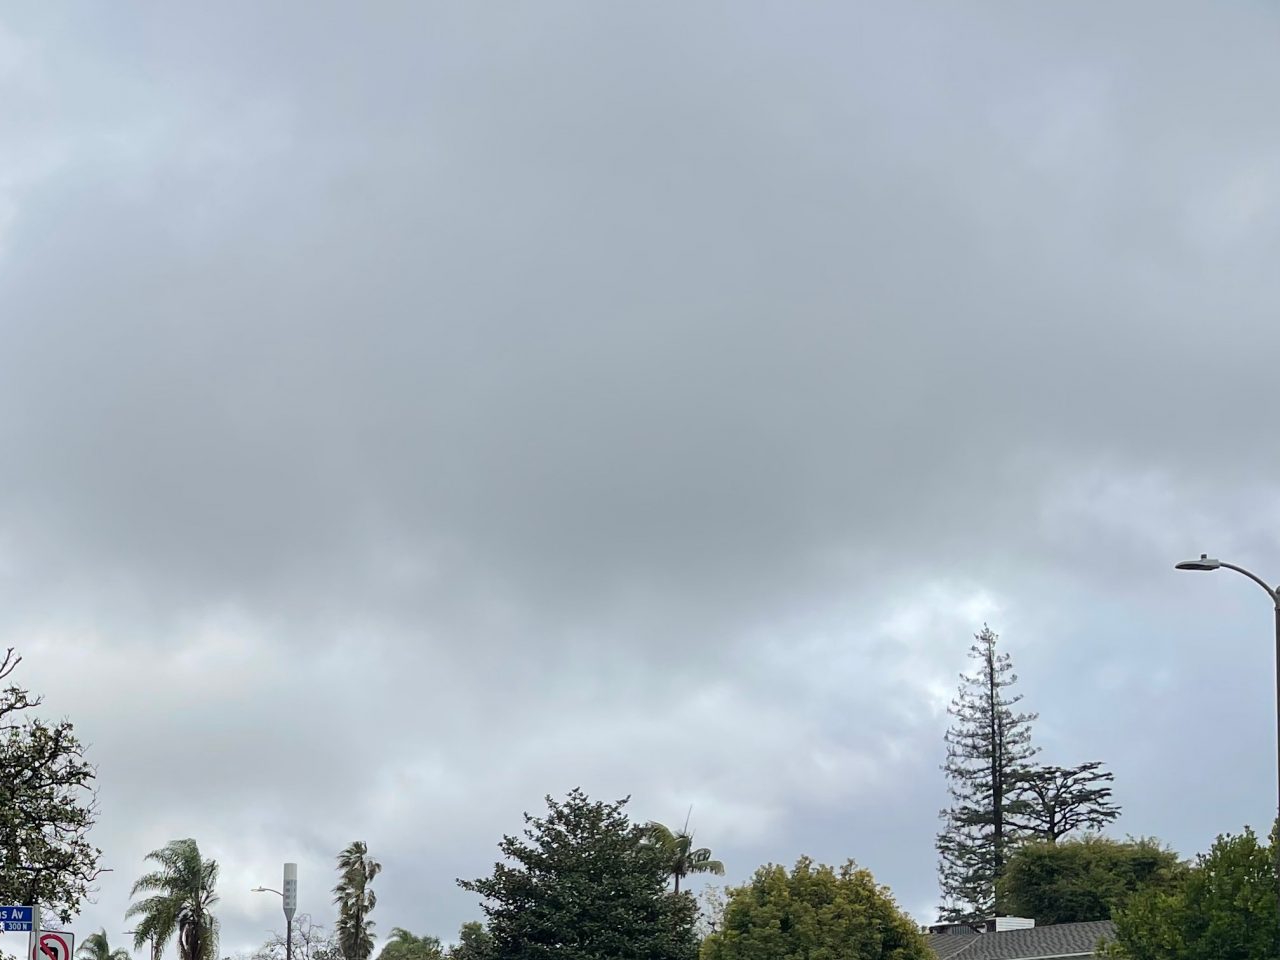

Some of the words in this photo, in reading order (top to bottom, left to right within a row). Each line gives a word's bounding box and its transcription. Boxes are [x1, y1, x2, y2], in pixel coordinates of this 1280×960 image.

[11, 908, 24, 920] Av
[8, 922, 22, 930] 300
[22, 923, 28, 931] N
